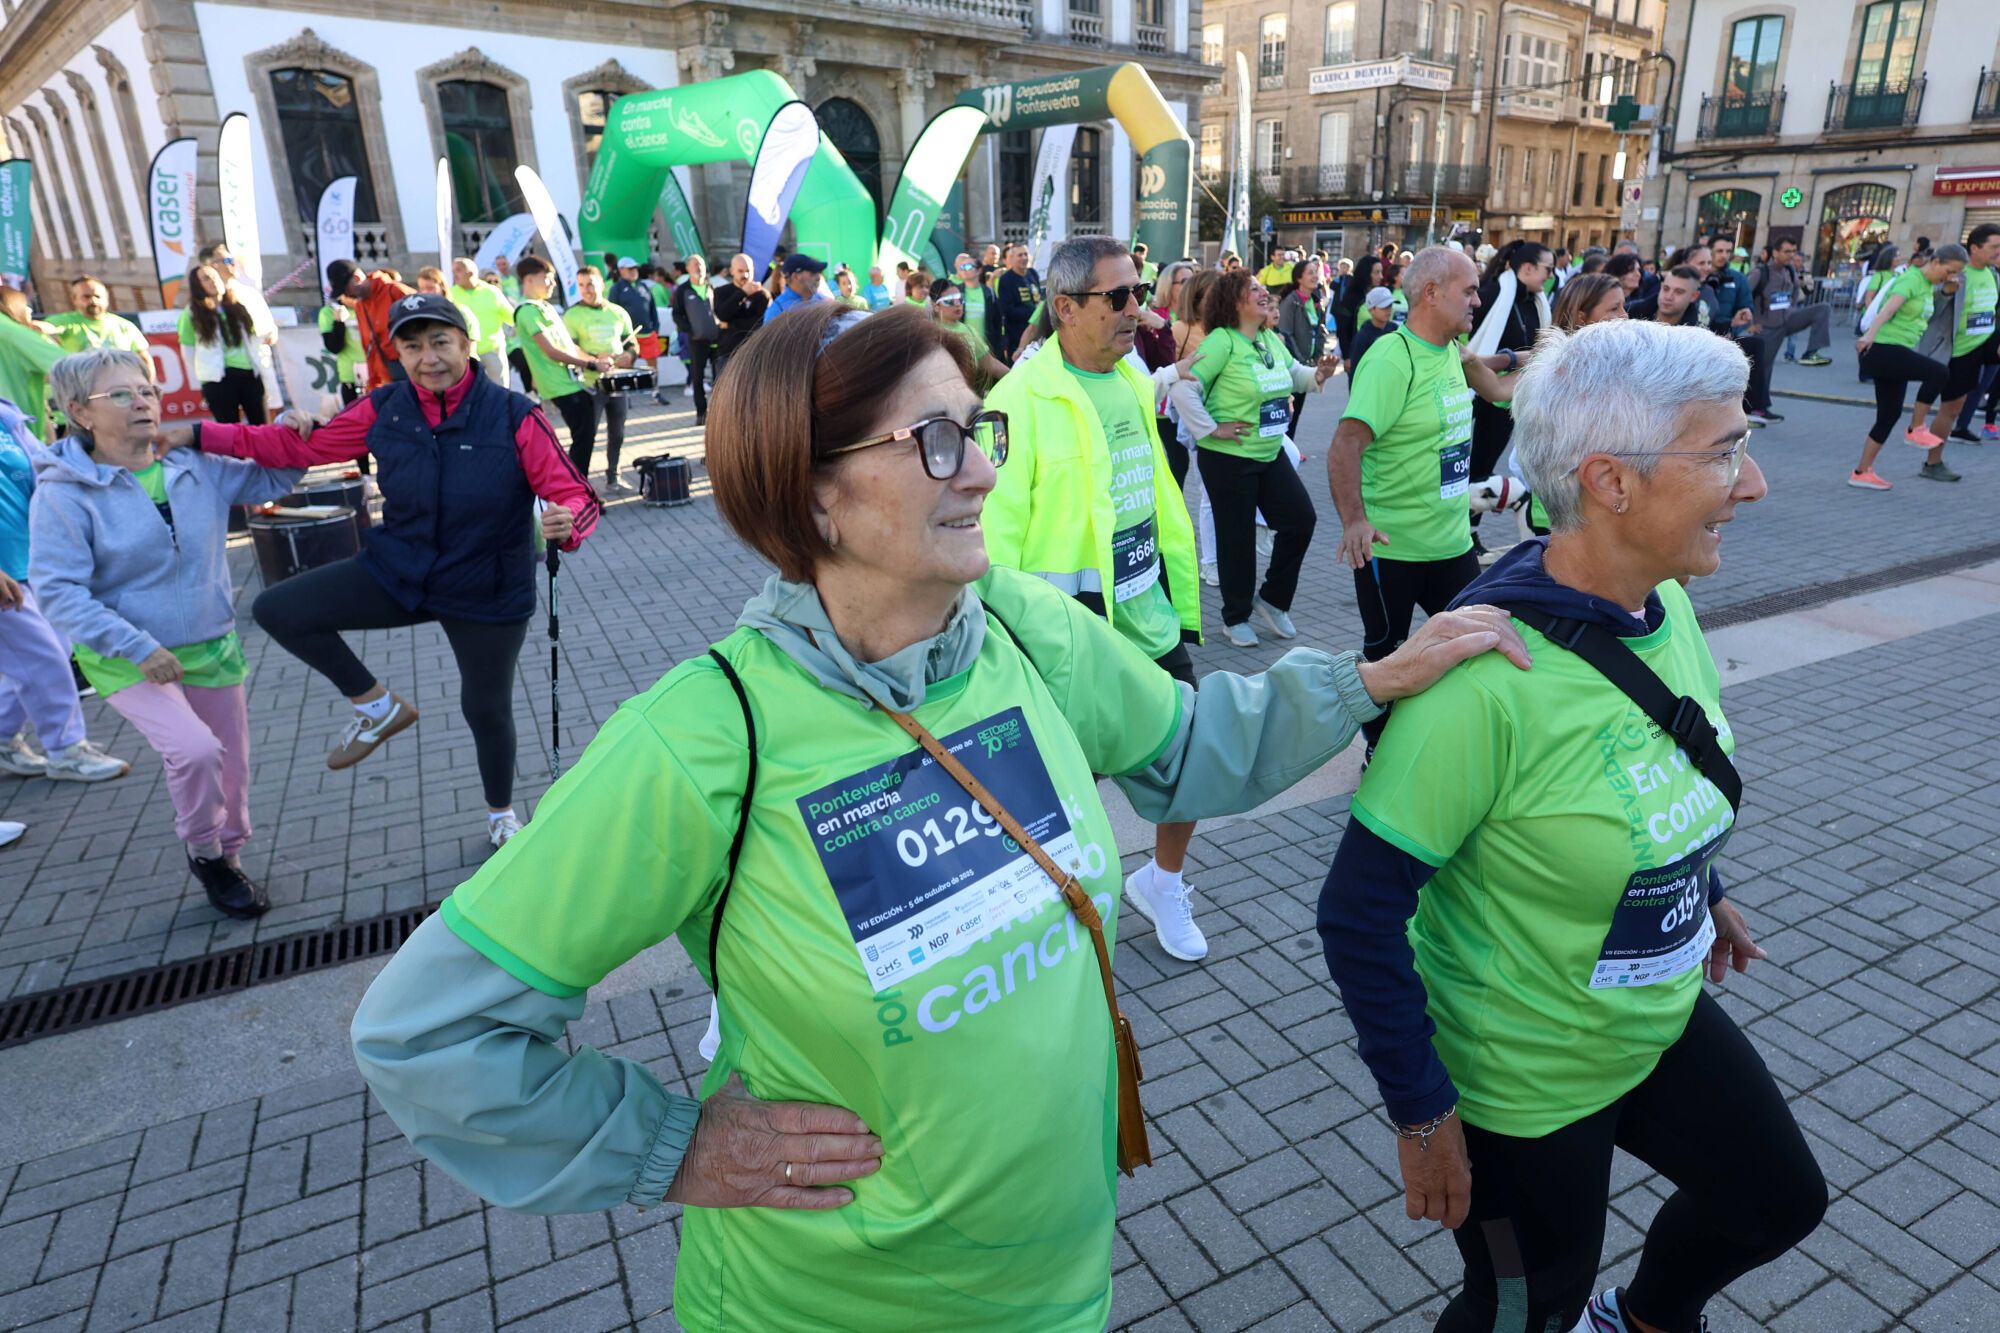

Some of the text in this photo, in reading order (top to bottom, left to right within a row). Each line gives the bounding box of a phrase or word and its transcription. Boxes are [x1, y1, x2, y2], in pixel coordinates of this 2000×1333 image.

[1016, 77, 1080, 100] Deputación
[1016, 94, 1080, 115] Pontevedra
[620, 115, 652, 132] contra
[157, 168, 181, 237] caser
[1270, 409, 1286, 419] 0171
[1128, 536, 1155, 567] 2668
[964, 739, 973, 747] ao
[1627, 761, 1671, 796] En
[808, 772, 902, 819] Pontevedra
[817, 791, 902, 836] en marcha
[824, 792, 940, 852] contra o cancro
[896, 799, 1003, 867] 0129
[1632, 864, 1691, 886] Pontevedra
[1628, 888, 1645, 897] en
[1648, 878, 1686, 896] marcha
[857, 920, 869, 931] VII
[869, 904, 903, 926] EDICIÓN
[908, 901, 914, 909] 5
[914, 895, 924, 905] de
[924, 881, 951, 900] outubro
[951, 876, 960, 886] de
[959, 868, 975, 881] 2025
[1624, 896, 1665, 907] contra
[1668, 894, 1674, 903] o
[1661, 875, 1700, 933] 0152
[960, 914, 982, 932] caser
[928, 932, 949, 951] NGP
[875, 958, 902, 977] CHS
[1634, 973, 1650, 981] NGP
